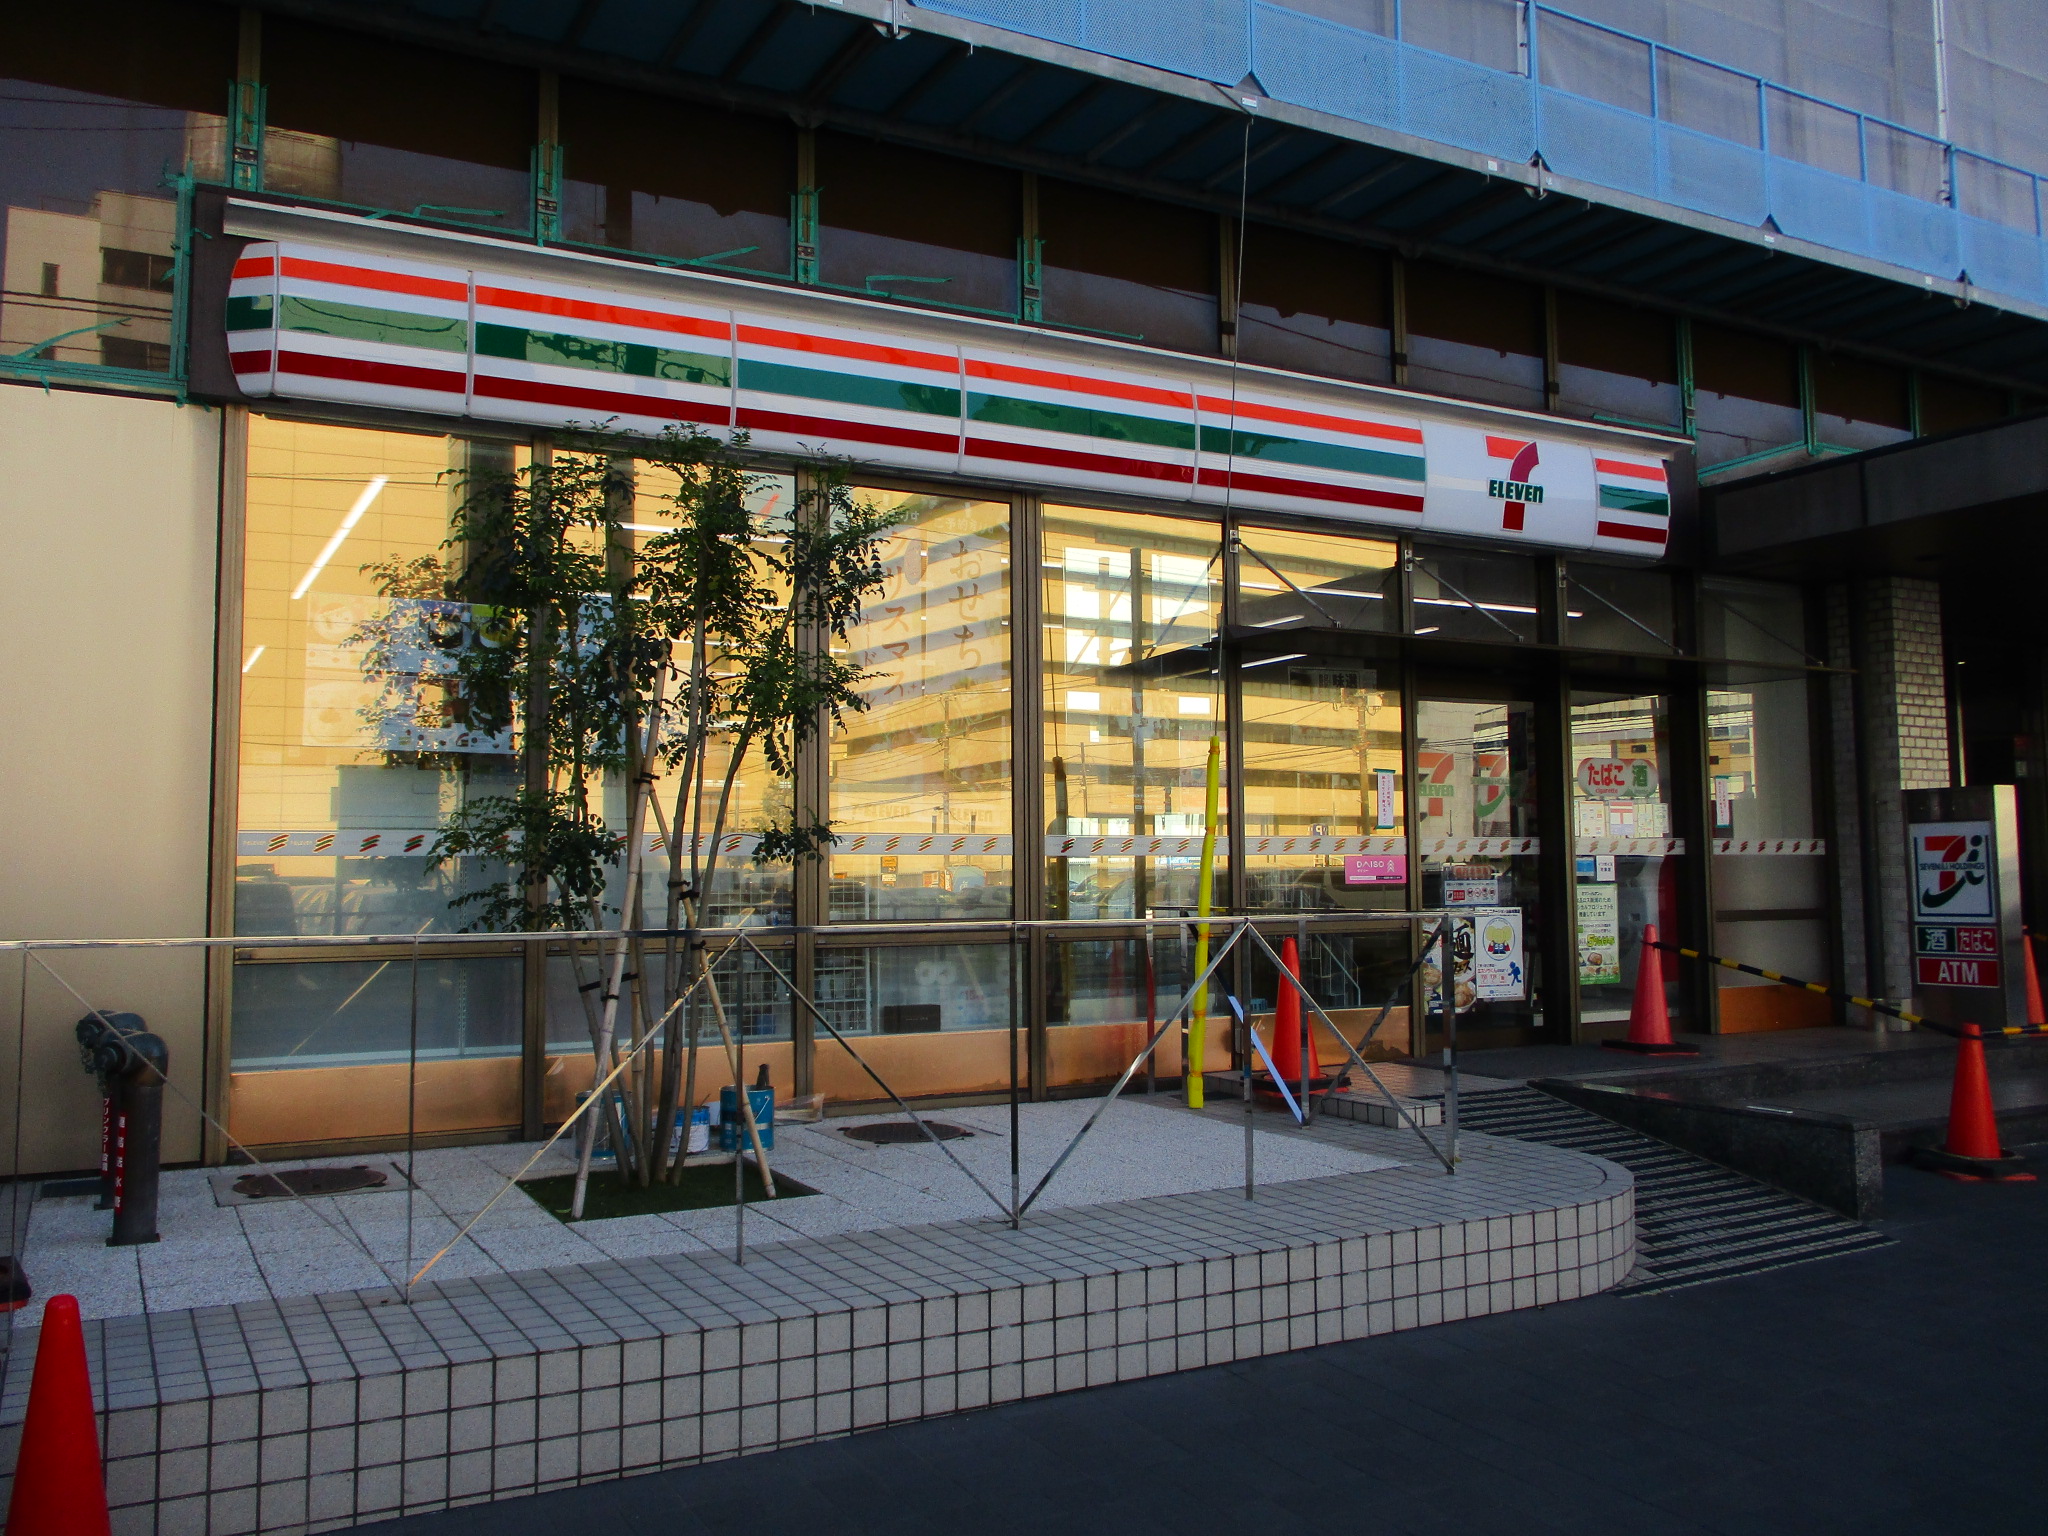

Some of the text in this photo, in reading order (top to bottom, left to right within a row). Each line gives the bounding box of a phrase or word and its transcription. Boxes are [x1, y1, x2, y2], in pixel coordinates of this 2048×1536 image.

[1485, 435, 1540, 532] 7
[1488, 480, 1544, 504] ELEVEN
[948, 540, 984, 671] おせち
[1587, 762, 1626, 786] たばこ
[1632, 765, 1649, 787] 酒
[1926, 928, 1948, 951] 酒
[1958, 930, 1995, 952] たばこ
[1938, 961, 1979, 985] ATM
